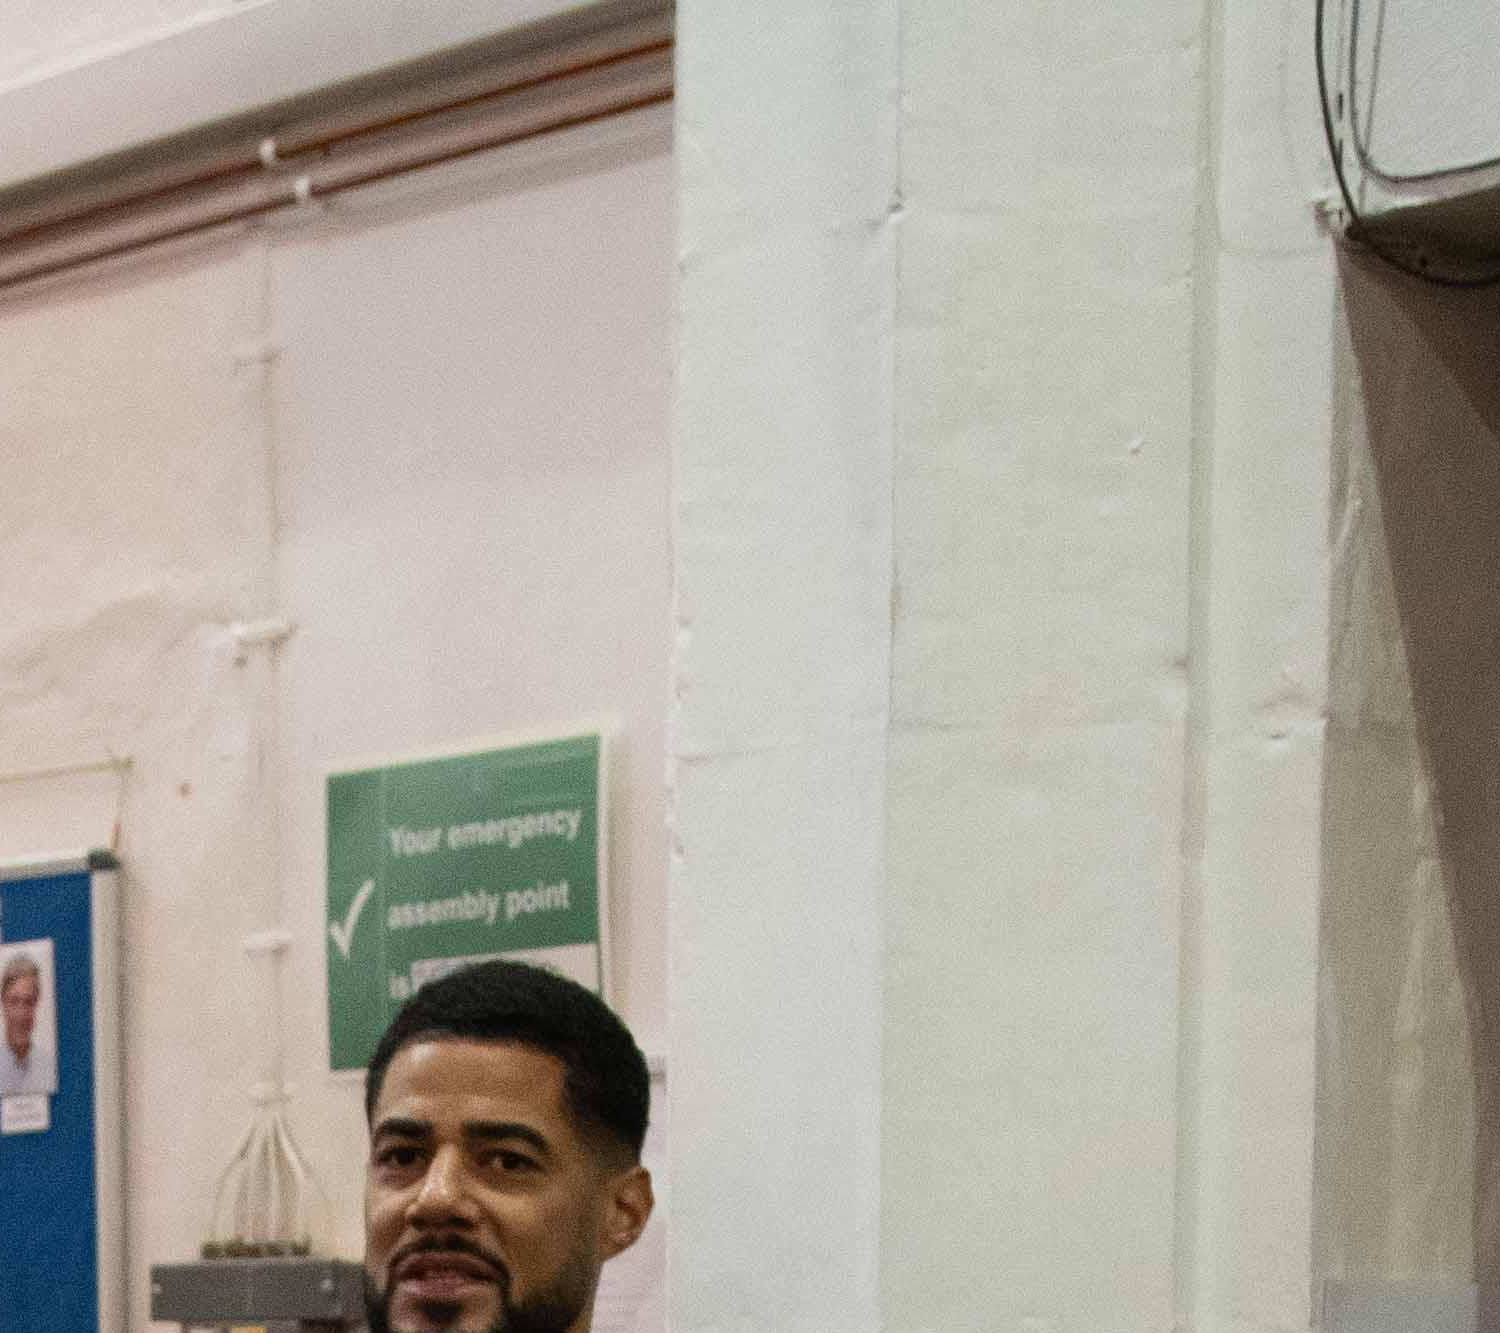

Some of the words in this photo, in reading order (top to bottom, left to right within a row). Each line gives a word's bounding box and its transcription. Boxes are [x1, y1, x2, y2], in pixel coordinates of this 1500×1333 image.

[390, 827, 441, 857] Your
[449, 811, 581, 848] emergency
[387, 889, 500, 928] assembly
[507, 880, 569, 918] point
